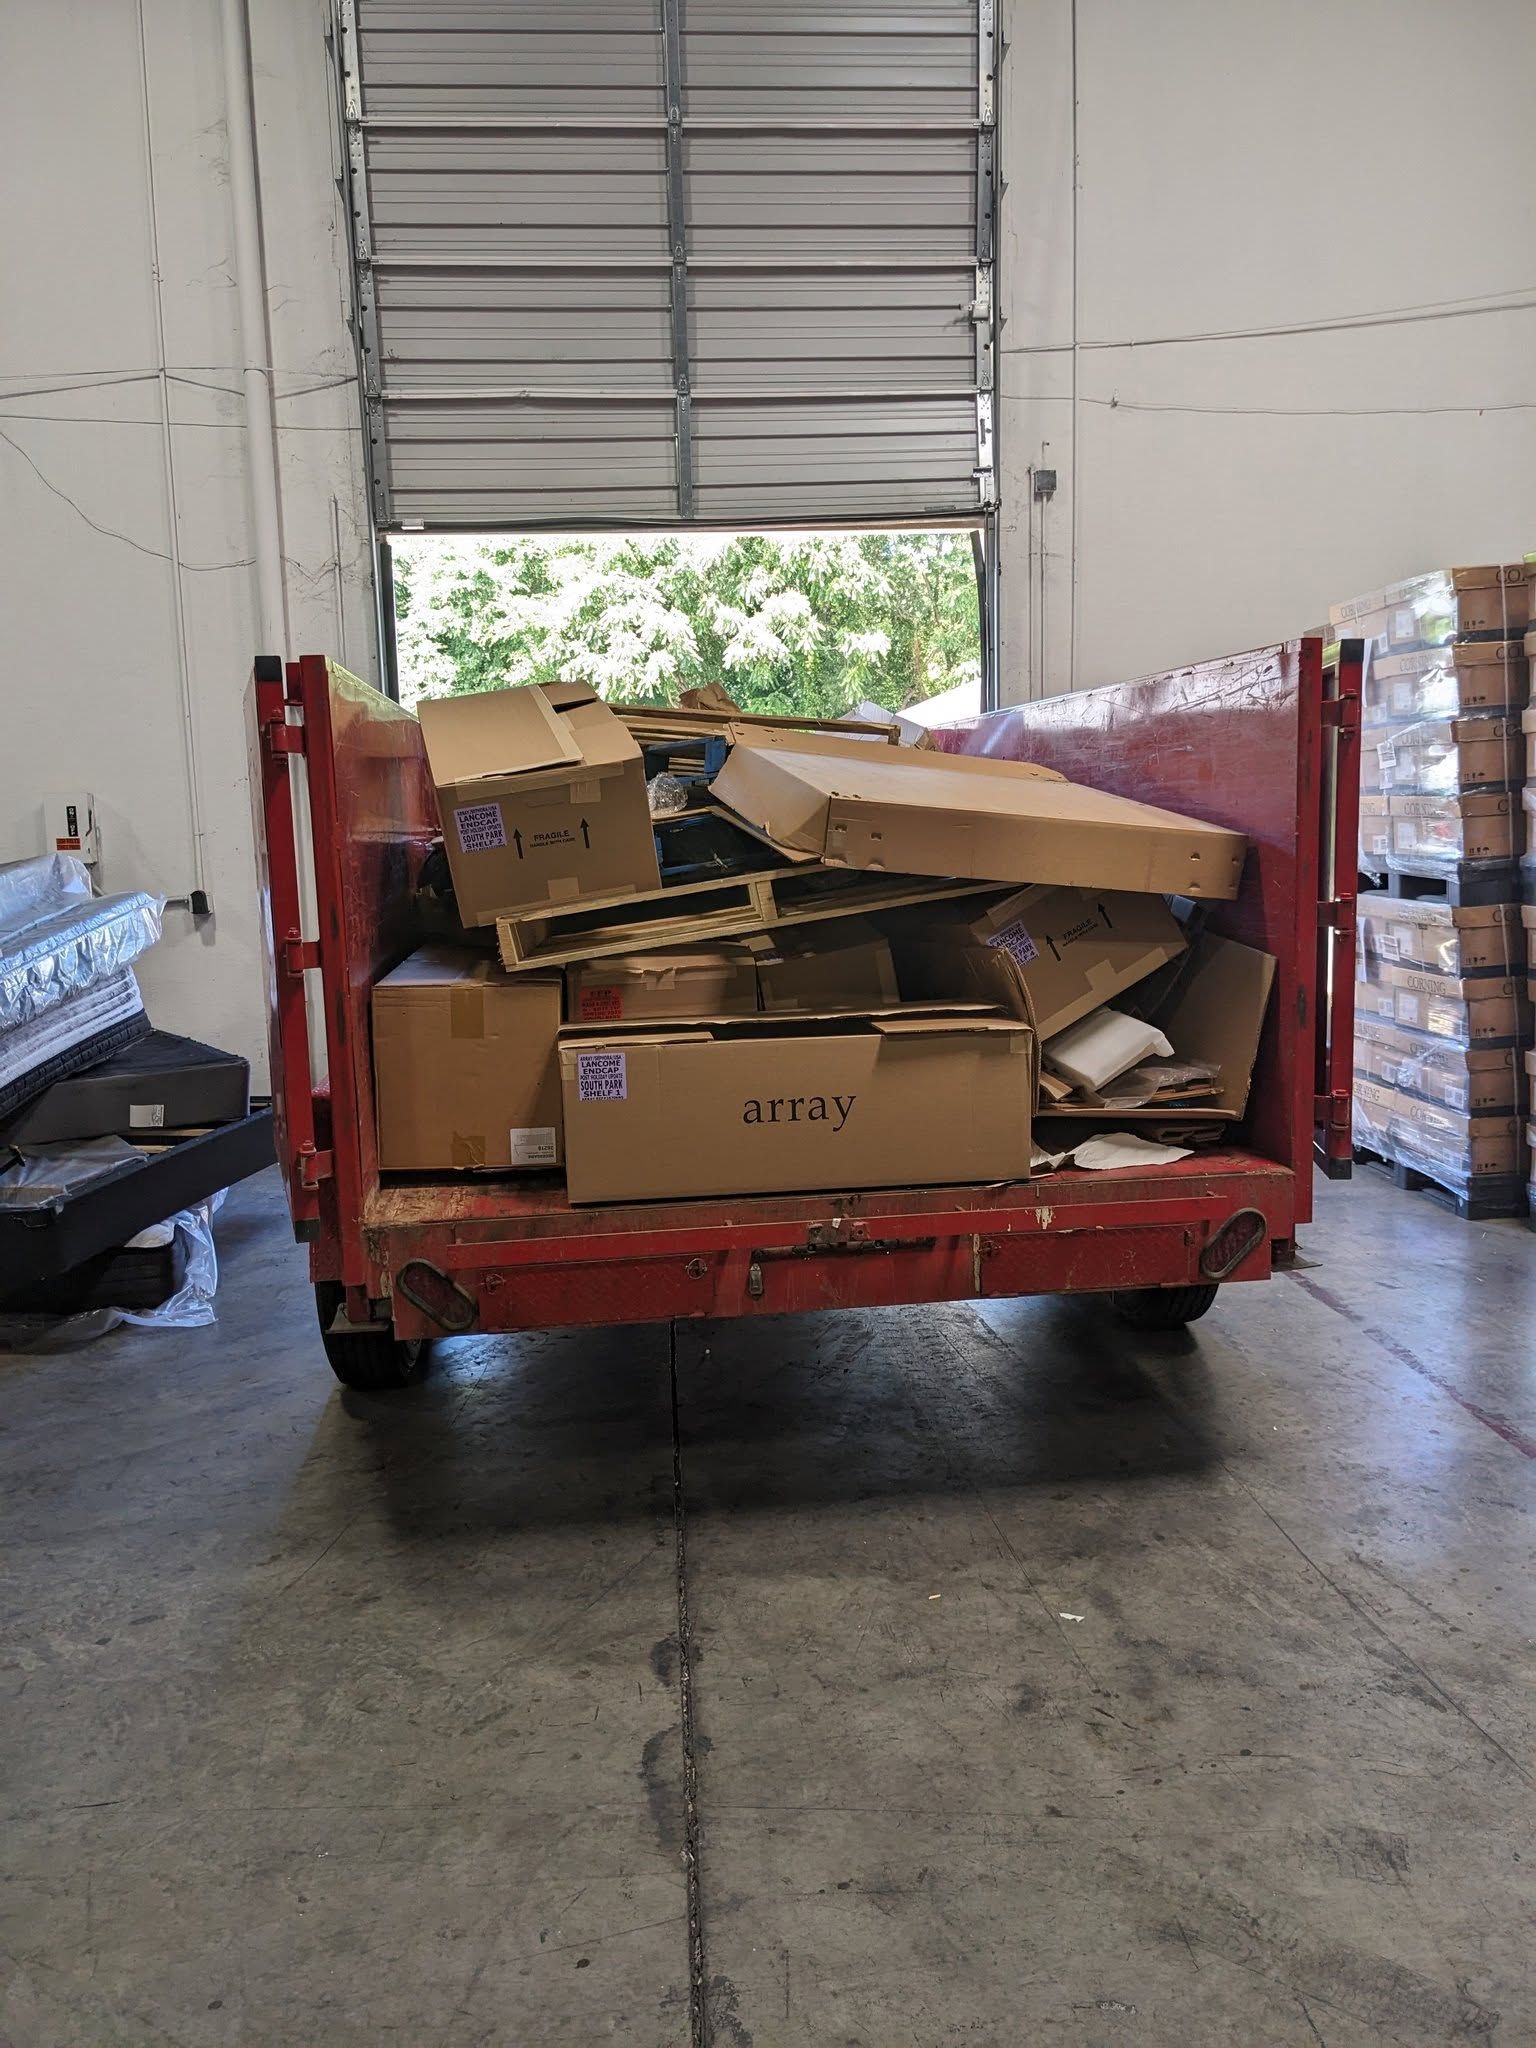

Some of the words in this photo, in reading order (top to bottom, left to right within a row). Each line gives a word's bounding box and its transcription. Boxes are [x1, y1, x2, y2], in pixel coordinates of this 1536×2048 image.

[459, 811, 497, 823] LANCOME
[461, 818, 498, 829] ENDCAP
[463, 832, 485, 843] SOUTH
[485, 829, 503, 840] PARK
[534, 830, 570, 841] FRAGILE
[466, 840, 494, 849] SHELF
[1064, 919, 1093, 940] FRAGILE
[1005, 933, 1025, 949] DCAP
[1407, 975, 1446, 995] CORNING
[581, 1060, 621, 1068] LANCOME
[583, 1067, 619, 1075] ENDCAP
[580, 1080, 603, 1091] SOUTH
[605, 1079, 623, 1090] PARK
[583, 1090, 613, 1098] SHELF
[743, 1095, 857, 1132] array
